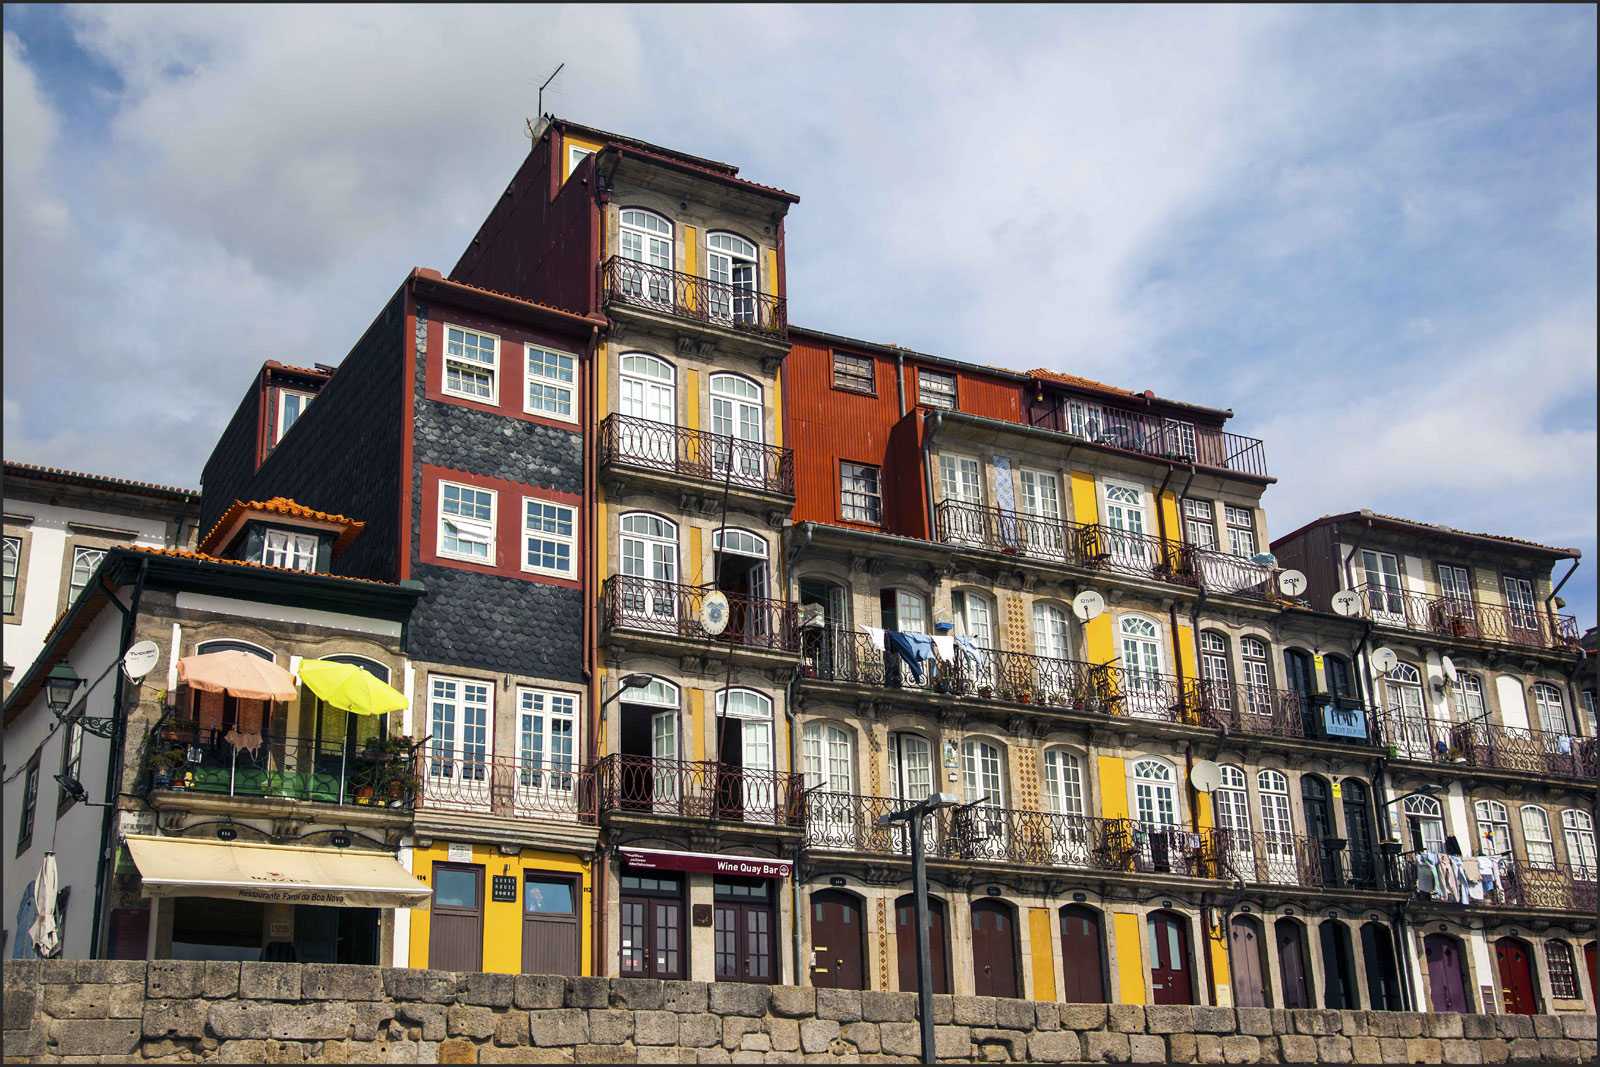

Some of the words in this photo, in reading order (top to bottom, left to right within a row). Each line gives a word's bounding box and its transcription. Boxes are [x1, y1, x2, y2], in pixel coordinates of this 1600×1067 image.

[1327, 725, 1346, 734] GUEST
[1346, 727, 1366, 736] HOUSE
[717, 861, 738, 871] Wine
[740, 864, 761, 875] Quay
[763, 865, 778, 874] Bar
[238, 889, 280, 900] Restaurante
[282, 892, 300, 901] Farol
[301, 893, 309, 901] da
[311, 893, 324, 902] Boa
[326, 894, 344, 903] Nova
